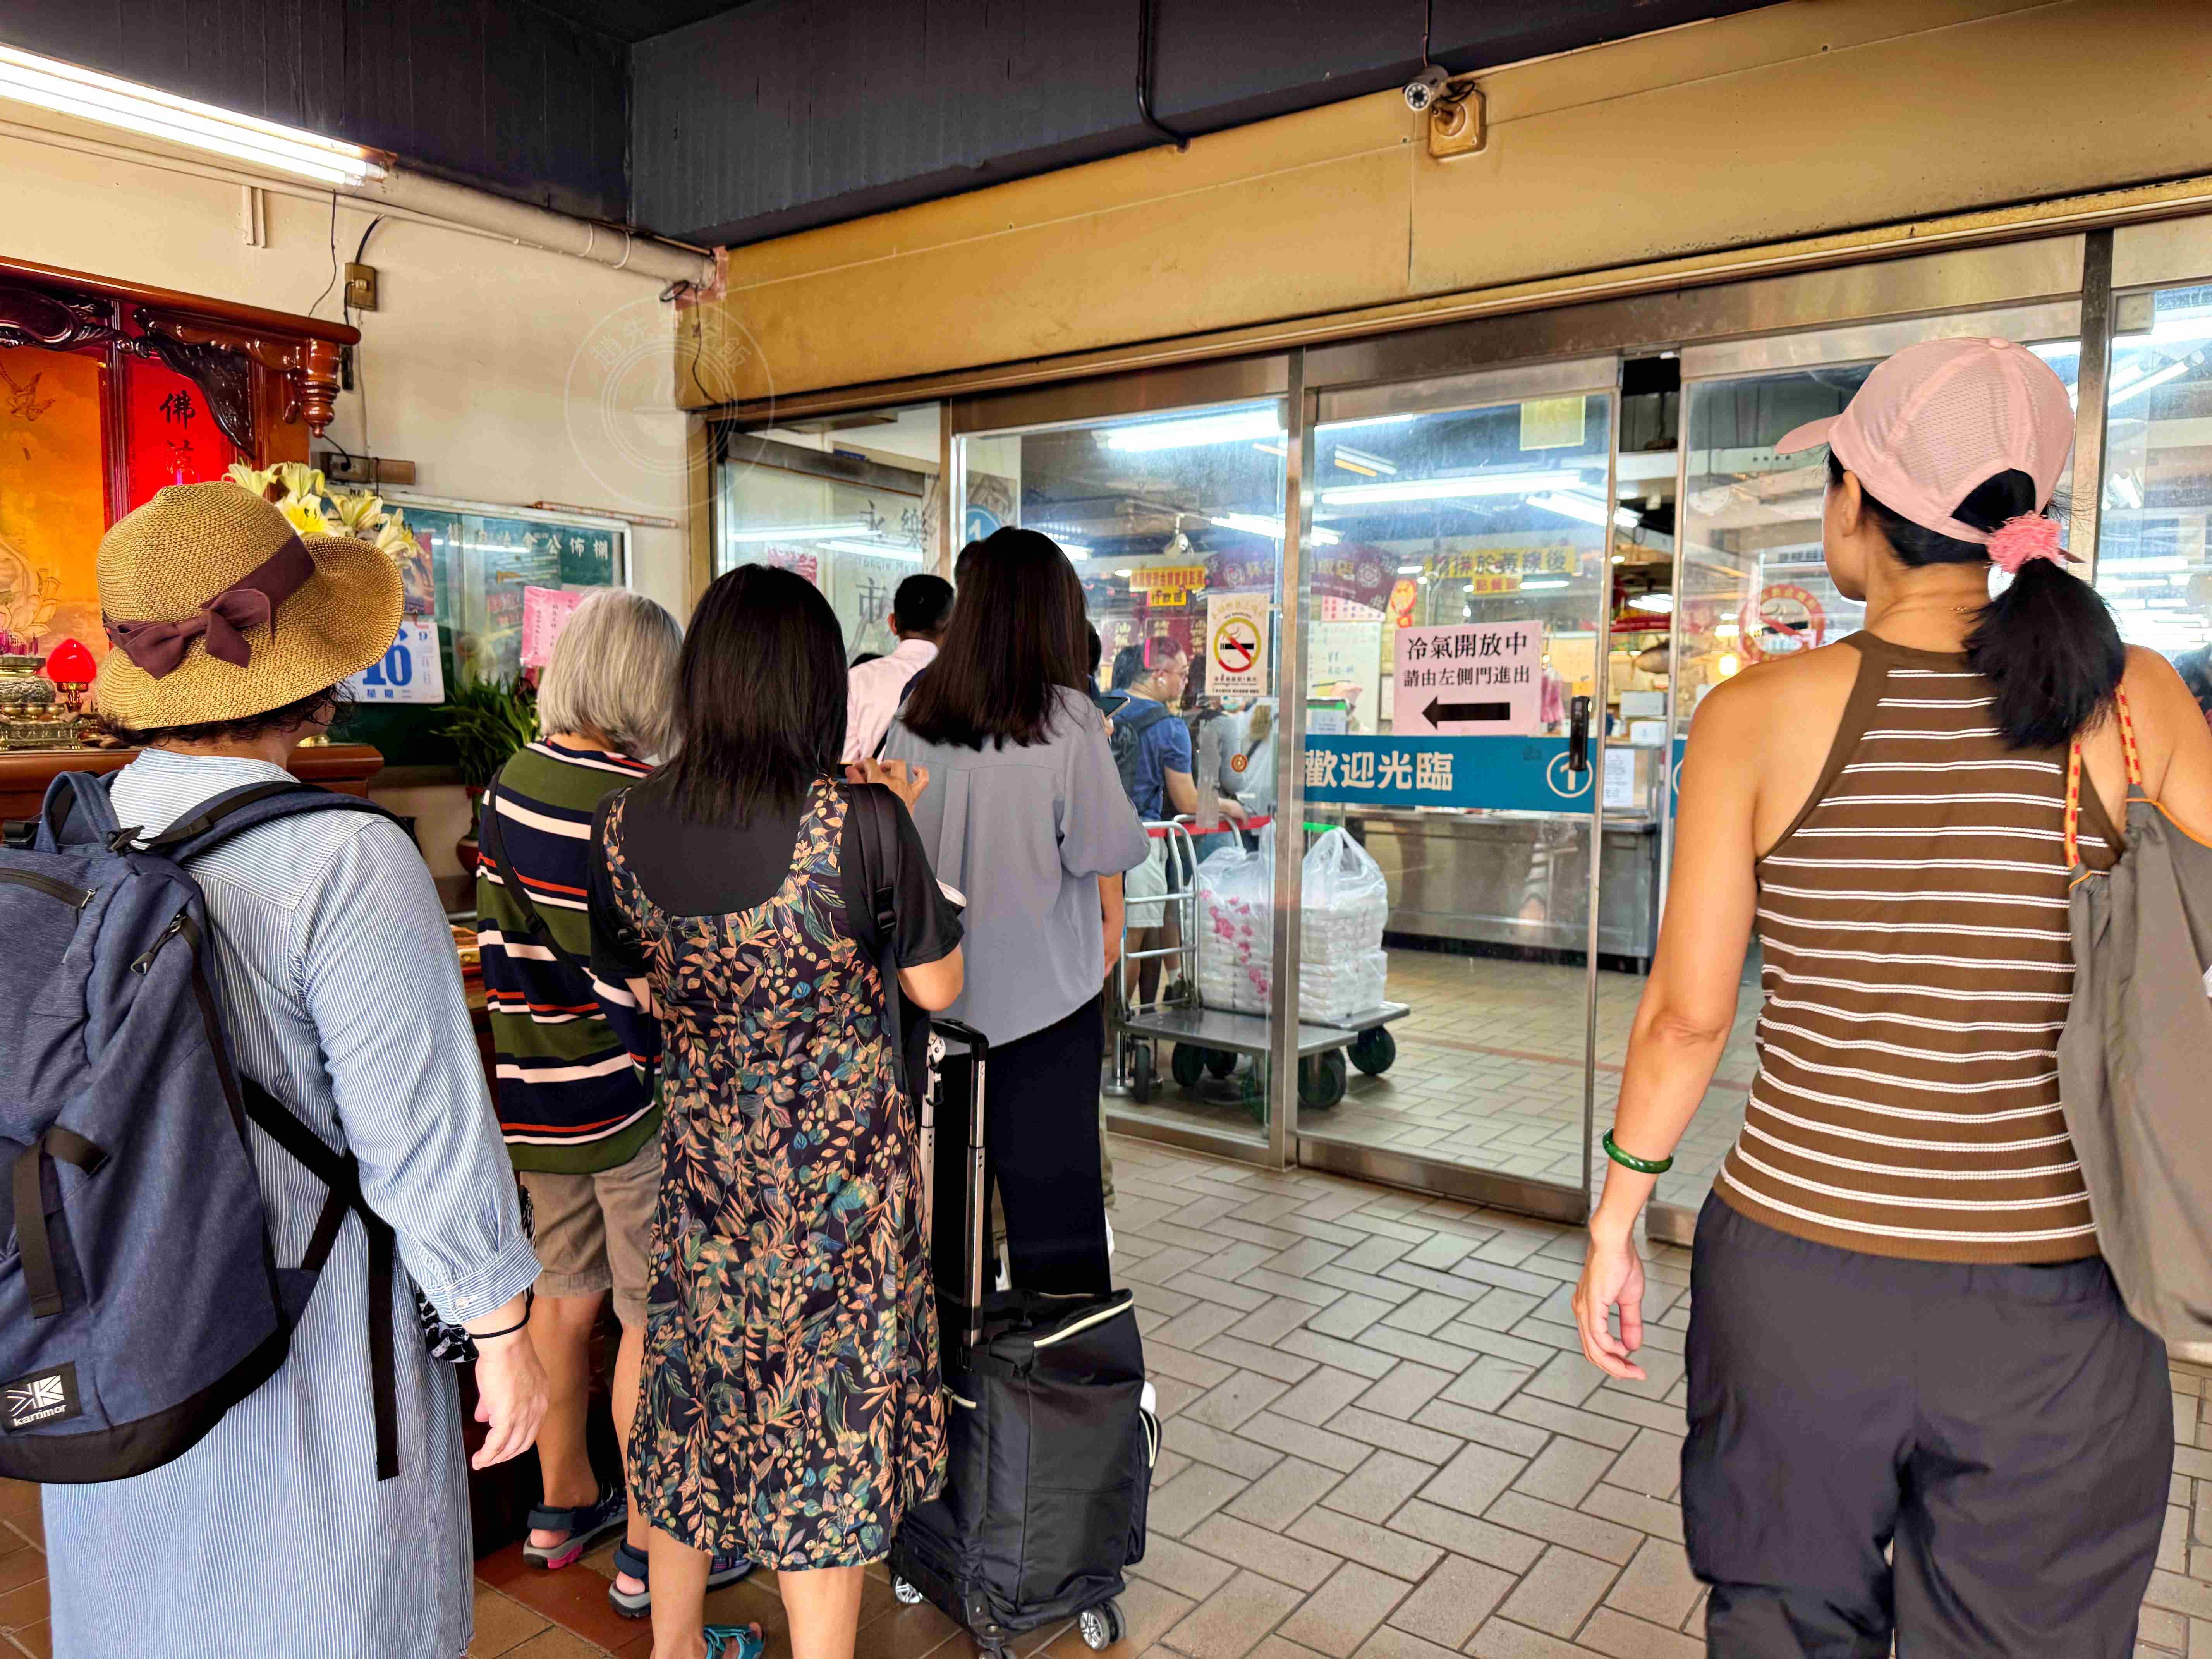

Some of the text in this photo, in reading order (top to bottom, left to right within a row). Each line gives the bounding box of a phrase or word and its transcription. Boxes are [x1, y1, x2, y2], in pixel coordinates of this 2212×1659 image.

[1408, 632, 1527, 660] 冷氣開放中
[1403, 665, 1529, 687] 請由左側門進出
[1305, 749, 1454, 792] 歡迎光臨
[12, 1404, 67, 1427] karrimor
